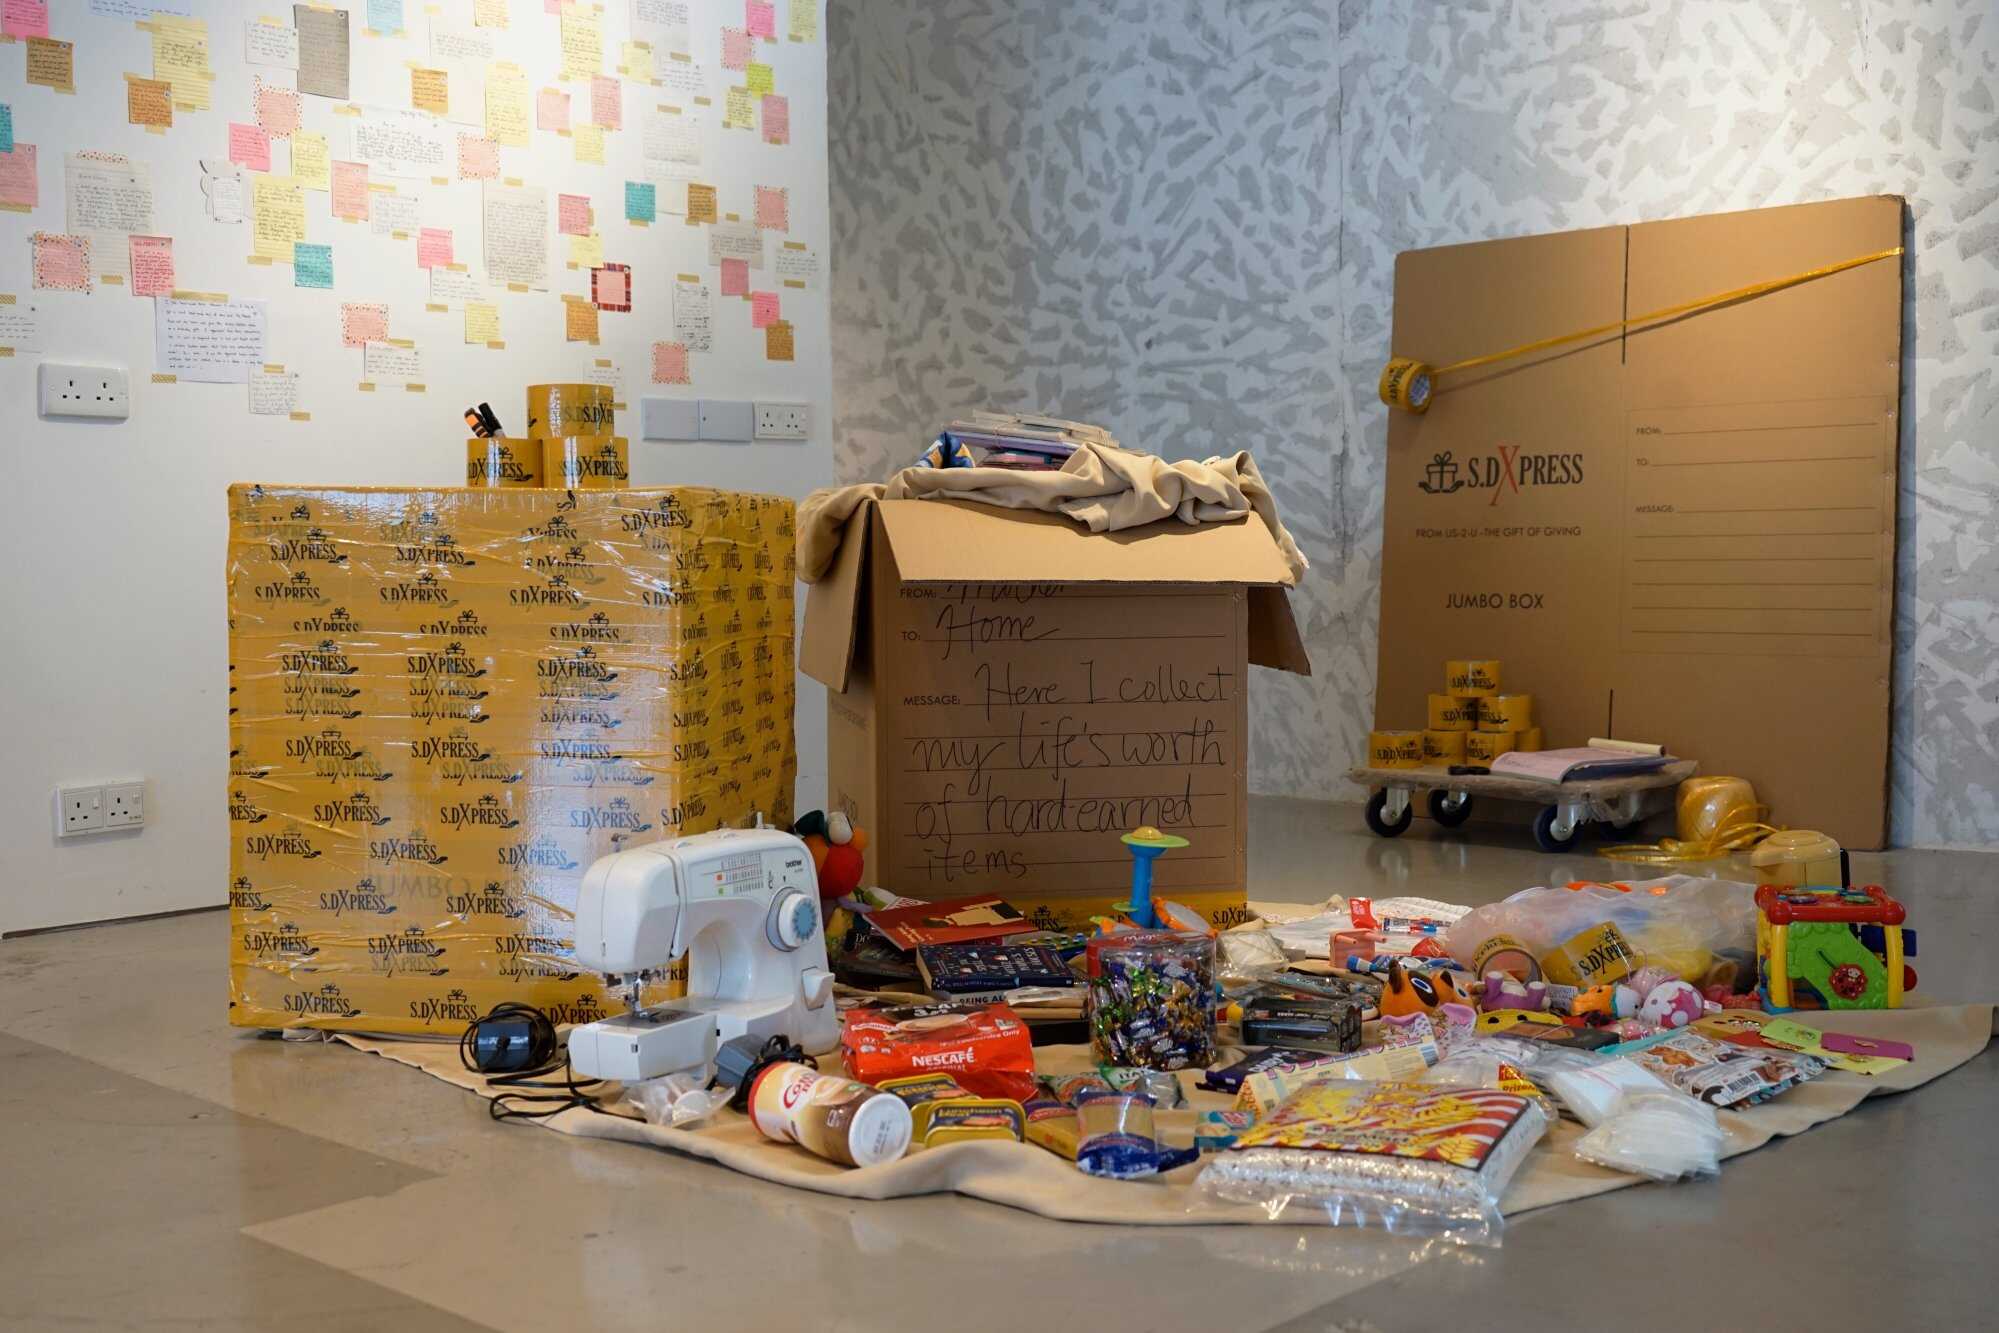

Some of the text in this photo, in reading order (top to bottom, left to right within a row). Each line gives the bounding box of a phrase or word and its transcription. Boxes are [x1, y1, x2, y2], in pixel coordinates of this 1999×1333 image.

[1467, 445, 1583, 506] S.DXPRESS
[1415, 528, 1443, 539] FROM
[1503, 527, 1524, 538] GIFT
[1527, 527, 1543, 537] OF
[1543, 526, 1582, 538] GIVING
[271, 540, 336, 565] S.DXPRESS
[900, 588, 937, 599] FROM:
[1446, 593, 1544, 609] JUMBO BOX
[902, 631, 921, 641] TO:
[935, 604, 1061, 660] Home
[282, 650, 348, 678] S.DXPRESS
[408, 652, 476, 680] S.DXPRESS
[537, 656, 607, 683] S.DXPRESS
[903, 696, 961, 706] MESSAGE:
[974, 661, 1234, 722] Here I collect
[286, 735, 351, 763] S.DXPRESS
[411, 737, 479, 765] S.DXPRESS
[912, 738, 1006, 796] my
[1122, 716, 1226, 766] worth
[314, 800, 380, 828] S.DXPRESS
[440, 803, 508, 831] S.DXPRESS
[570, 808, 640, 835] S.DXPRESS
[915, 783, 957, 845] of
[247, 834, 311, 860] S.DXPRESS
[369, 838, 437, 865] S.DXPRESS
[498, 844, 568, 871] S.DXPRESS
[923, 849, 1028, 882] items
[320, 889, 386, 917] S.DXPRESS
[446, 892, 514, 918] S.DXPRESS
[244, 931, 309, 957] S.DXPRESS
[368, 934, 435, 960] S.DXPRESS
[284, 992, 350, 1019] S.DXPRESS
[410, 998, 478, 1025] S.DXPRESS
[912, 1047, 975, 1067] NESCAFÉ
